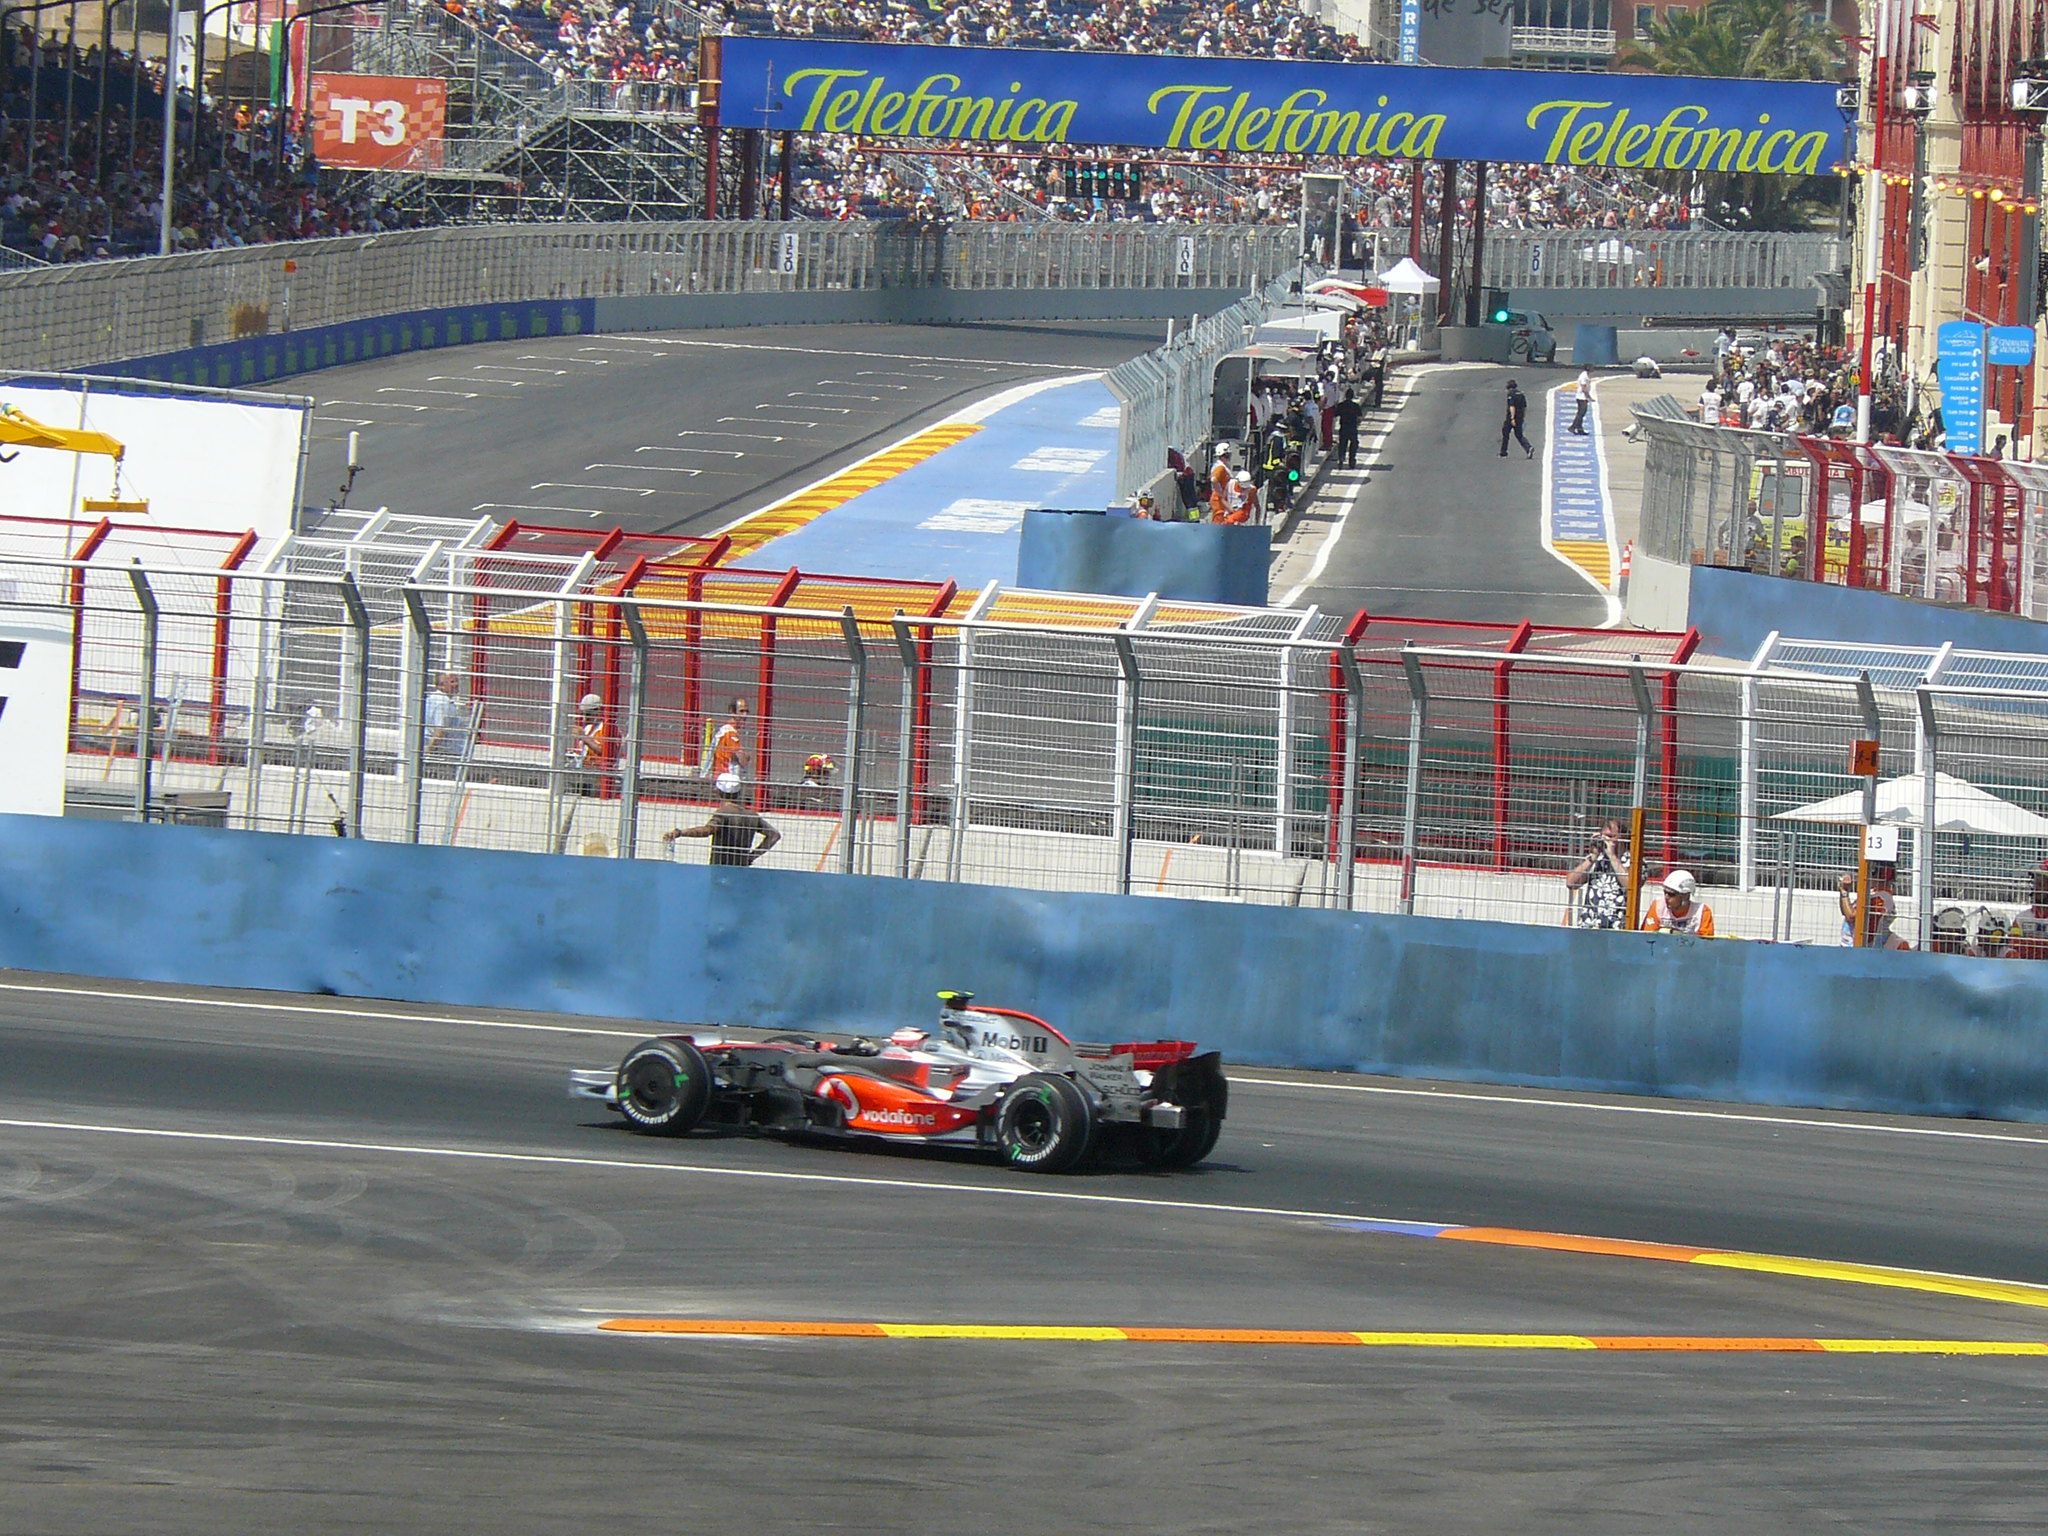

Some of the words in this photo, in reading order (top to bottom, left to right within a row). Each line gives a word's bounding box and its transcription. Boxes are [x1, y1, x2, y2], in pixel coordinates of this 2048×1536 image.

[330, 98, 406, 146] T3
[783, 236, 793, 272] 150
[1180, 239, 1190, 272] 100
[1532, 245, 1540, 271] 50
[1868, 836, 1882, 848] 13
[982, 1031, 1031, 1051] Mobil
[861, 1107, 935, 1125] vodafone
